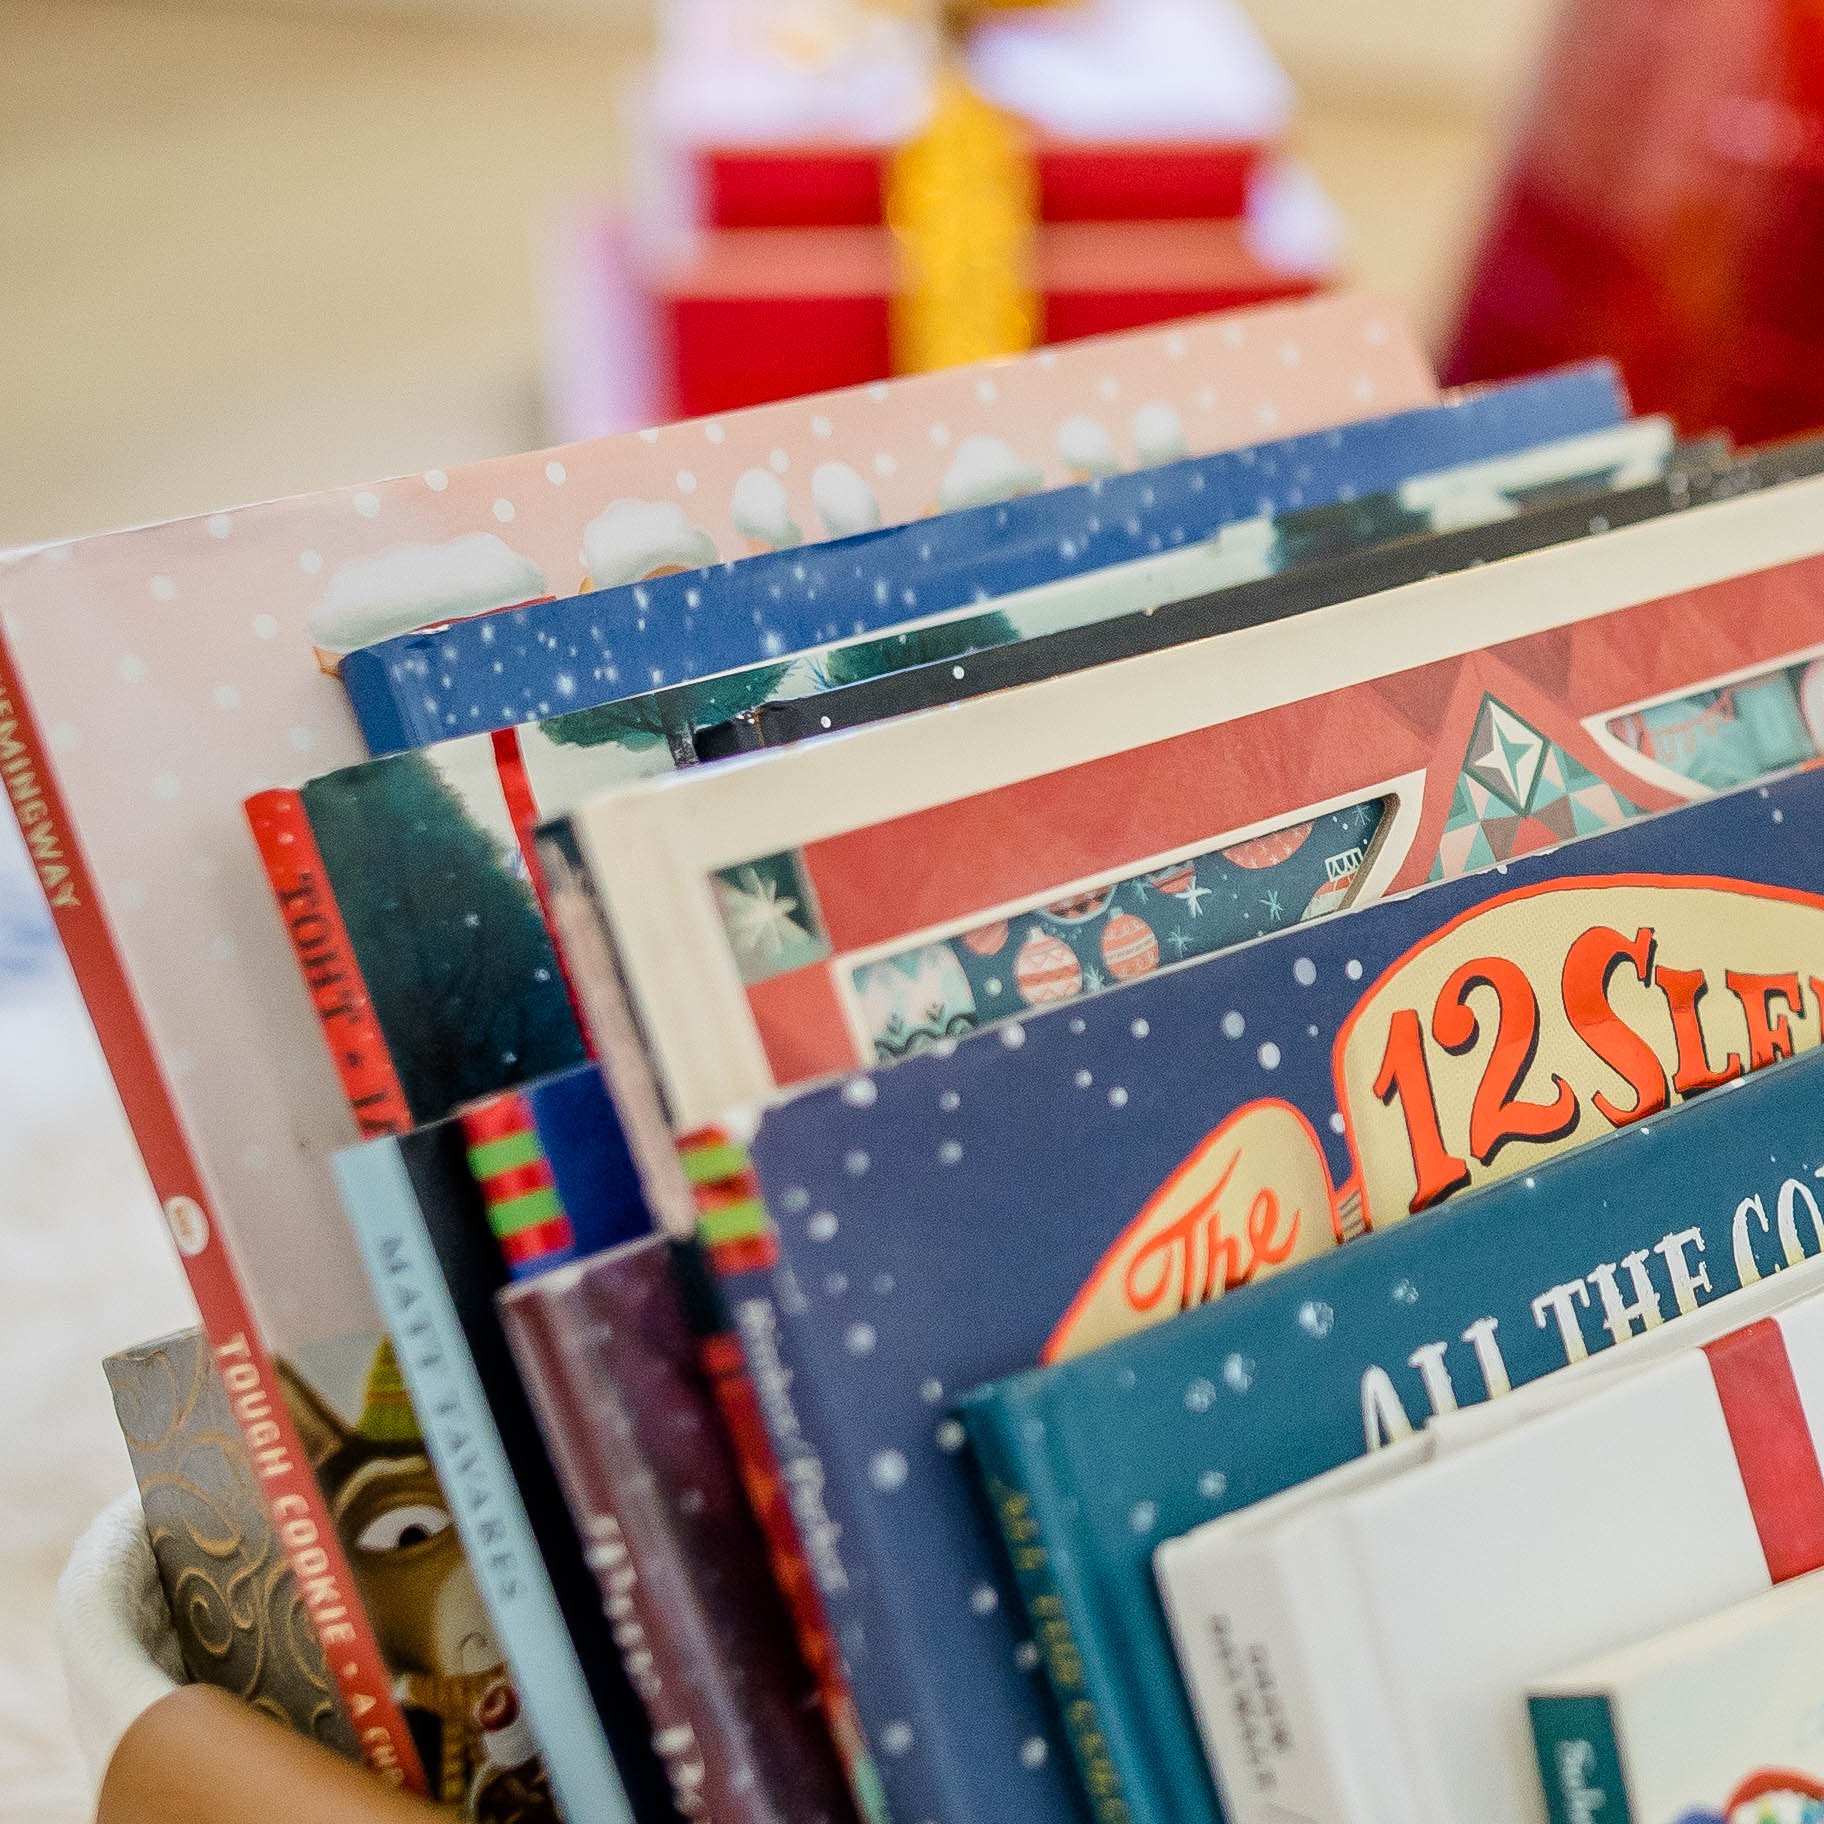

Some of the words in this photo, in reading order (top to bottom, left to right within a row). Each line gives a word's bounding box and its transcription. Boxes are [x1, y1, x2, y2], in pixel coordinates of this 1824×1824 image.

[0, 684, 81, 908] EMINGWAY
[1125, 1148, 1300, 1312] The
[1373, 956, 1580, 1213] 12
[1533, 1225, 1713, 1365] THE
[215, 1331, 294, 1478] TOUGH
[274, 1493, 357, 1644] COOKIE
